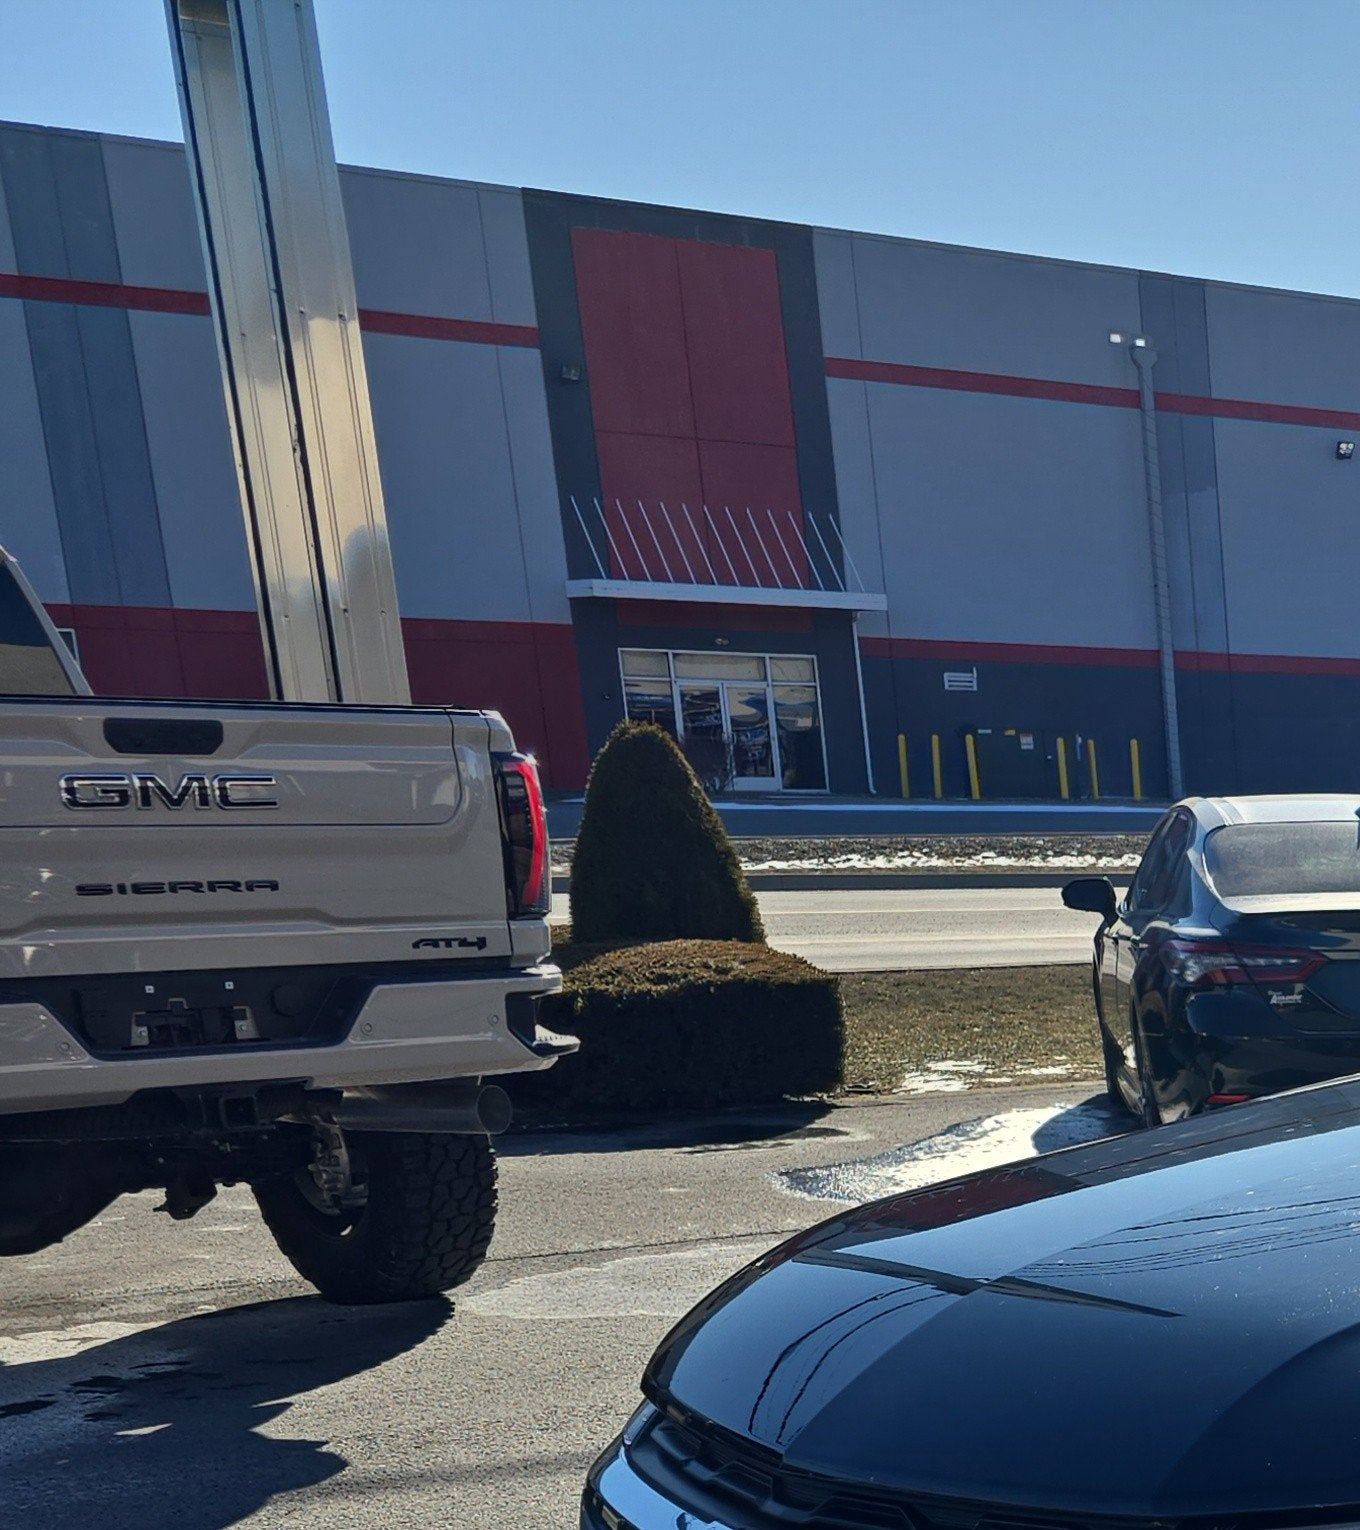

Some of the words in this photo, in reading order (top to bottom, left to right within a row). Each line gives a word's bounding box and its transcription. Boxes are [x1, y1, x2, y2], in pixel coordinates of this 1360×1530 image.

[59, 773, 279, 810] GMC
[75, 879, 280, 897] SIERRA
[412, 936, 487, 951] AT4
